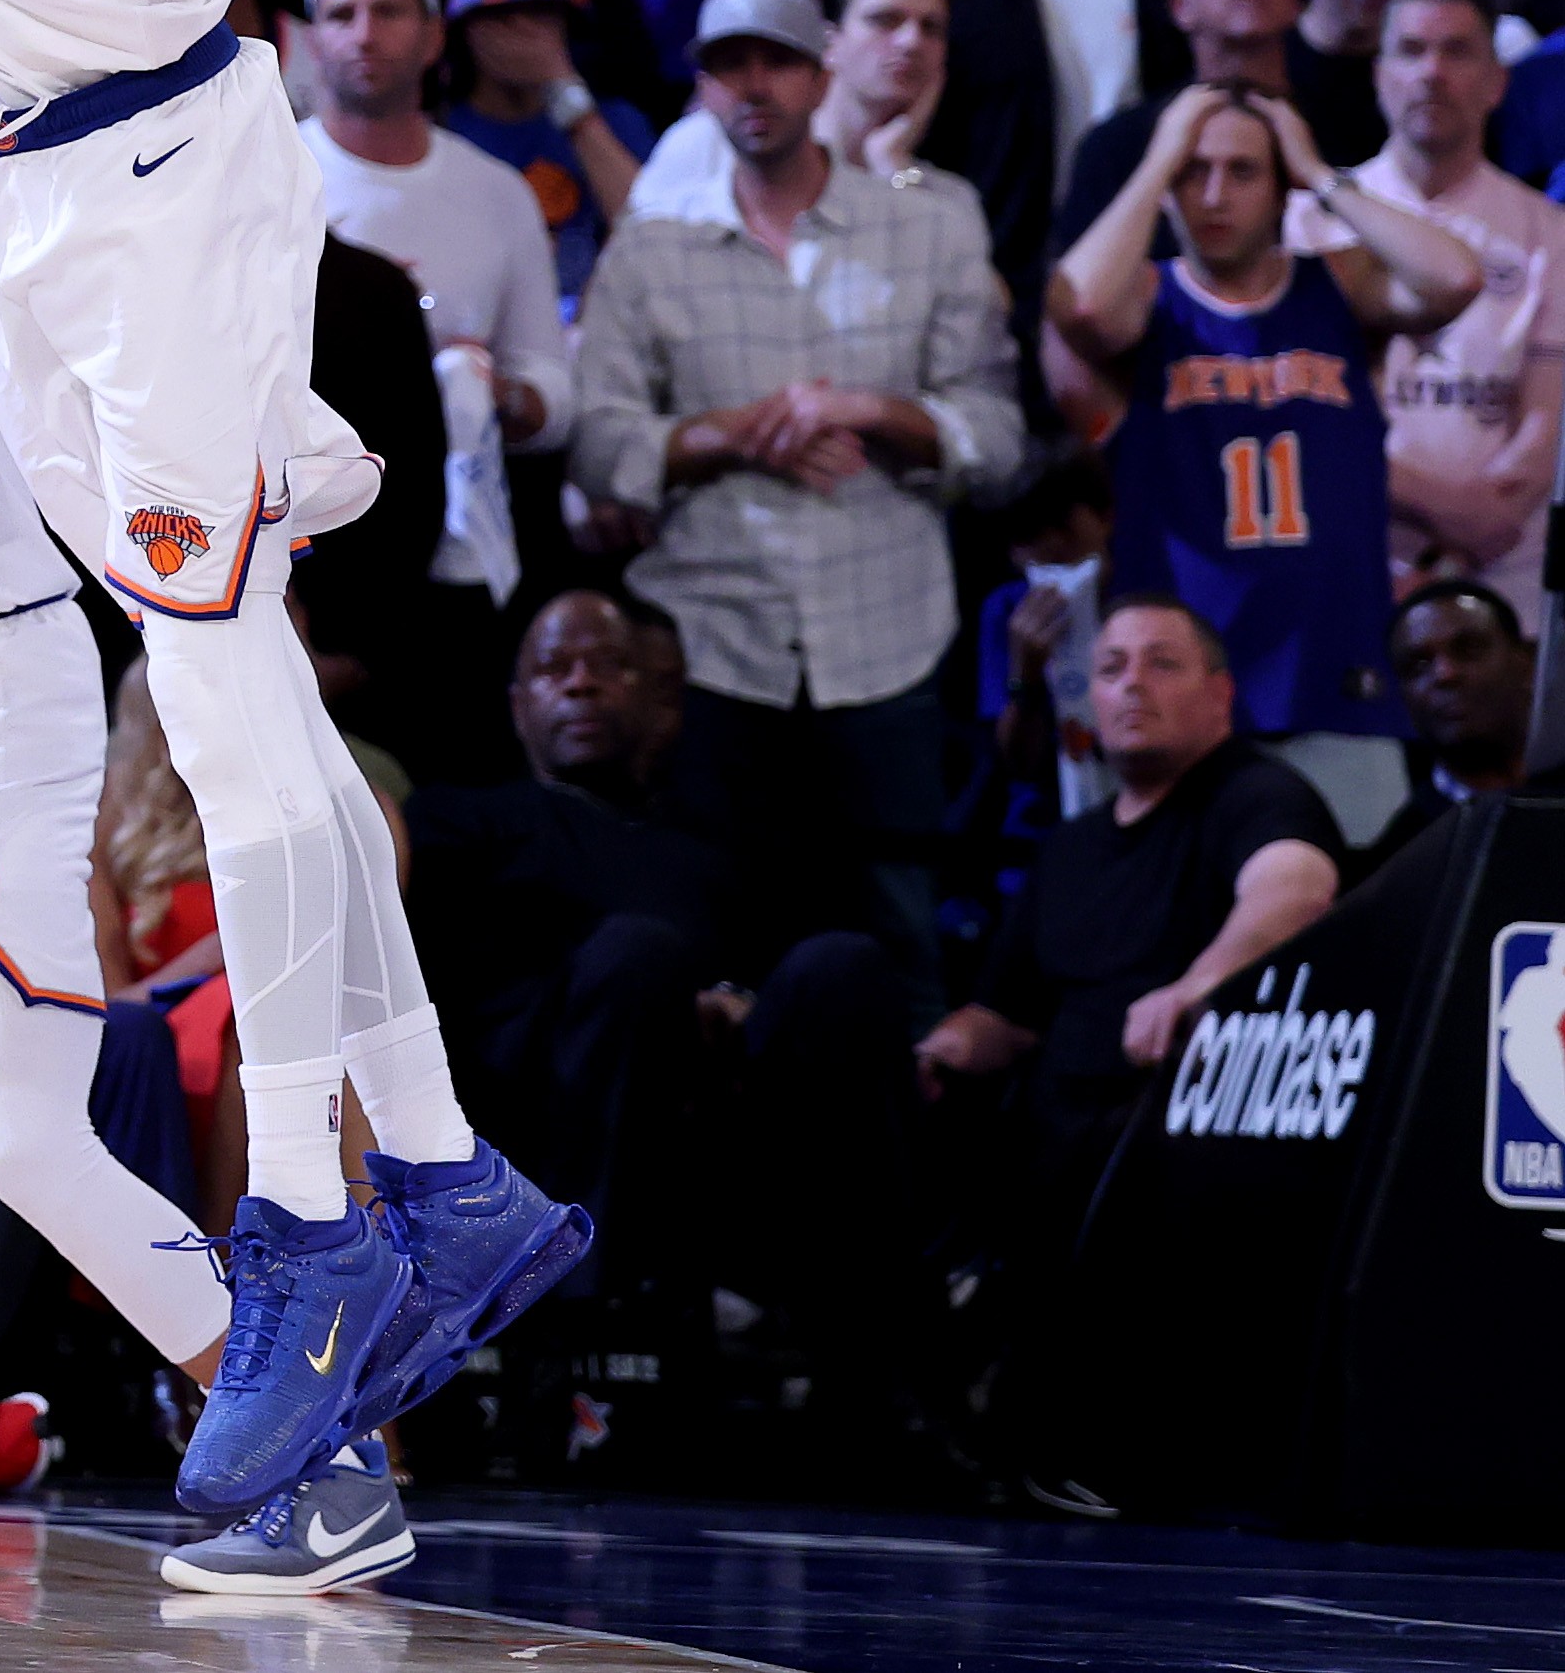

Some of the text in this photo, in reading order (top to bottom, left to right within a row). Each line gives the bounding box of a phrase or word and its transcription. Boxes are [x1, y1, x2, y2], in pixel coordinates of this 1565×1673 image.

[127, 508, 211, 552] KNICKS
[1220, 429, 1309, 549] 11
[1166, 962, 1375, 1141] coinbase
[1502, 1140, 1563, 1189] NBA
